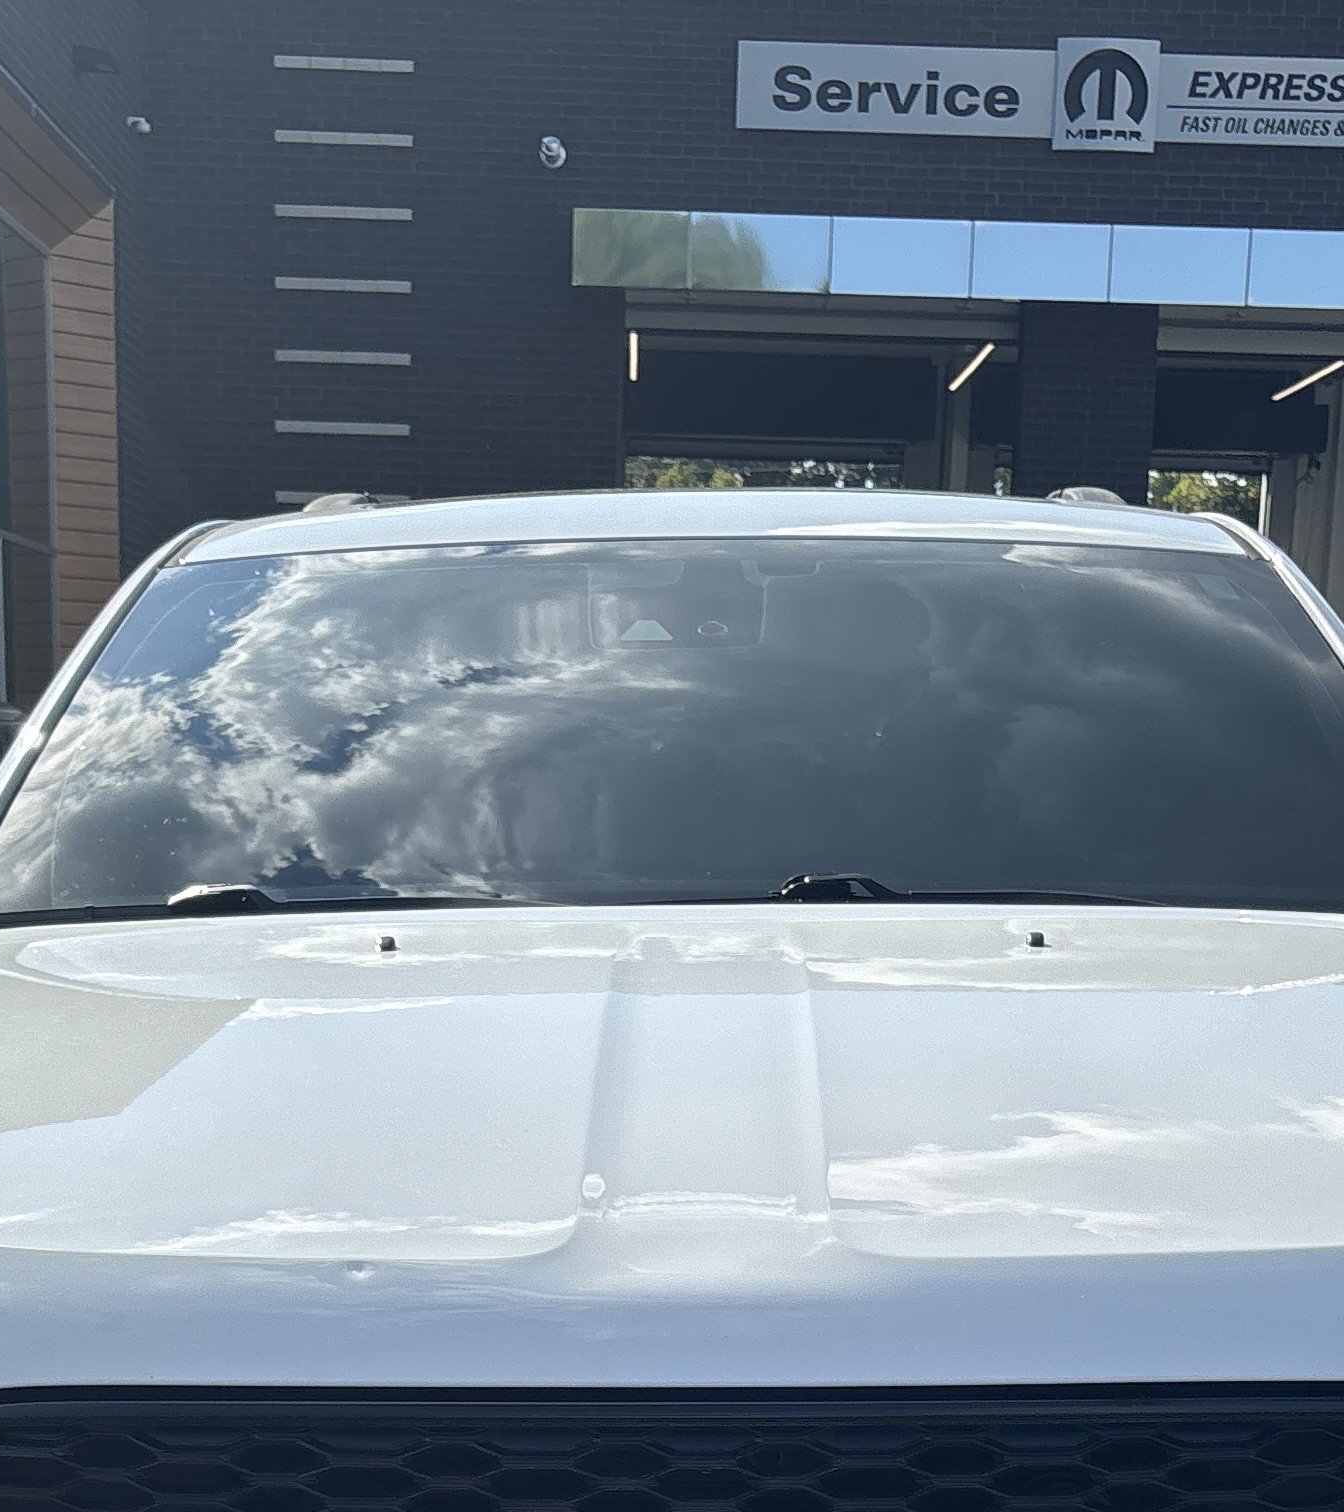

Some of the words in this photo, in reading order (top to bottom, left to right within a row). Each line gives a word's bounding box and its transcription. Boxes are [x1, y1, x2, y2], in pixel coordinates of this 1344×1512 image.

[772, 65, 1020, 118] Service
[1065, 128, 1143, 141] MOPAR
[1179, 115, 1219, 134] FAST
[1223, 117, 1249, 135] OIL
[1253, 118, 1331, 138] CHANGES
